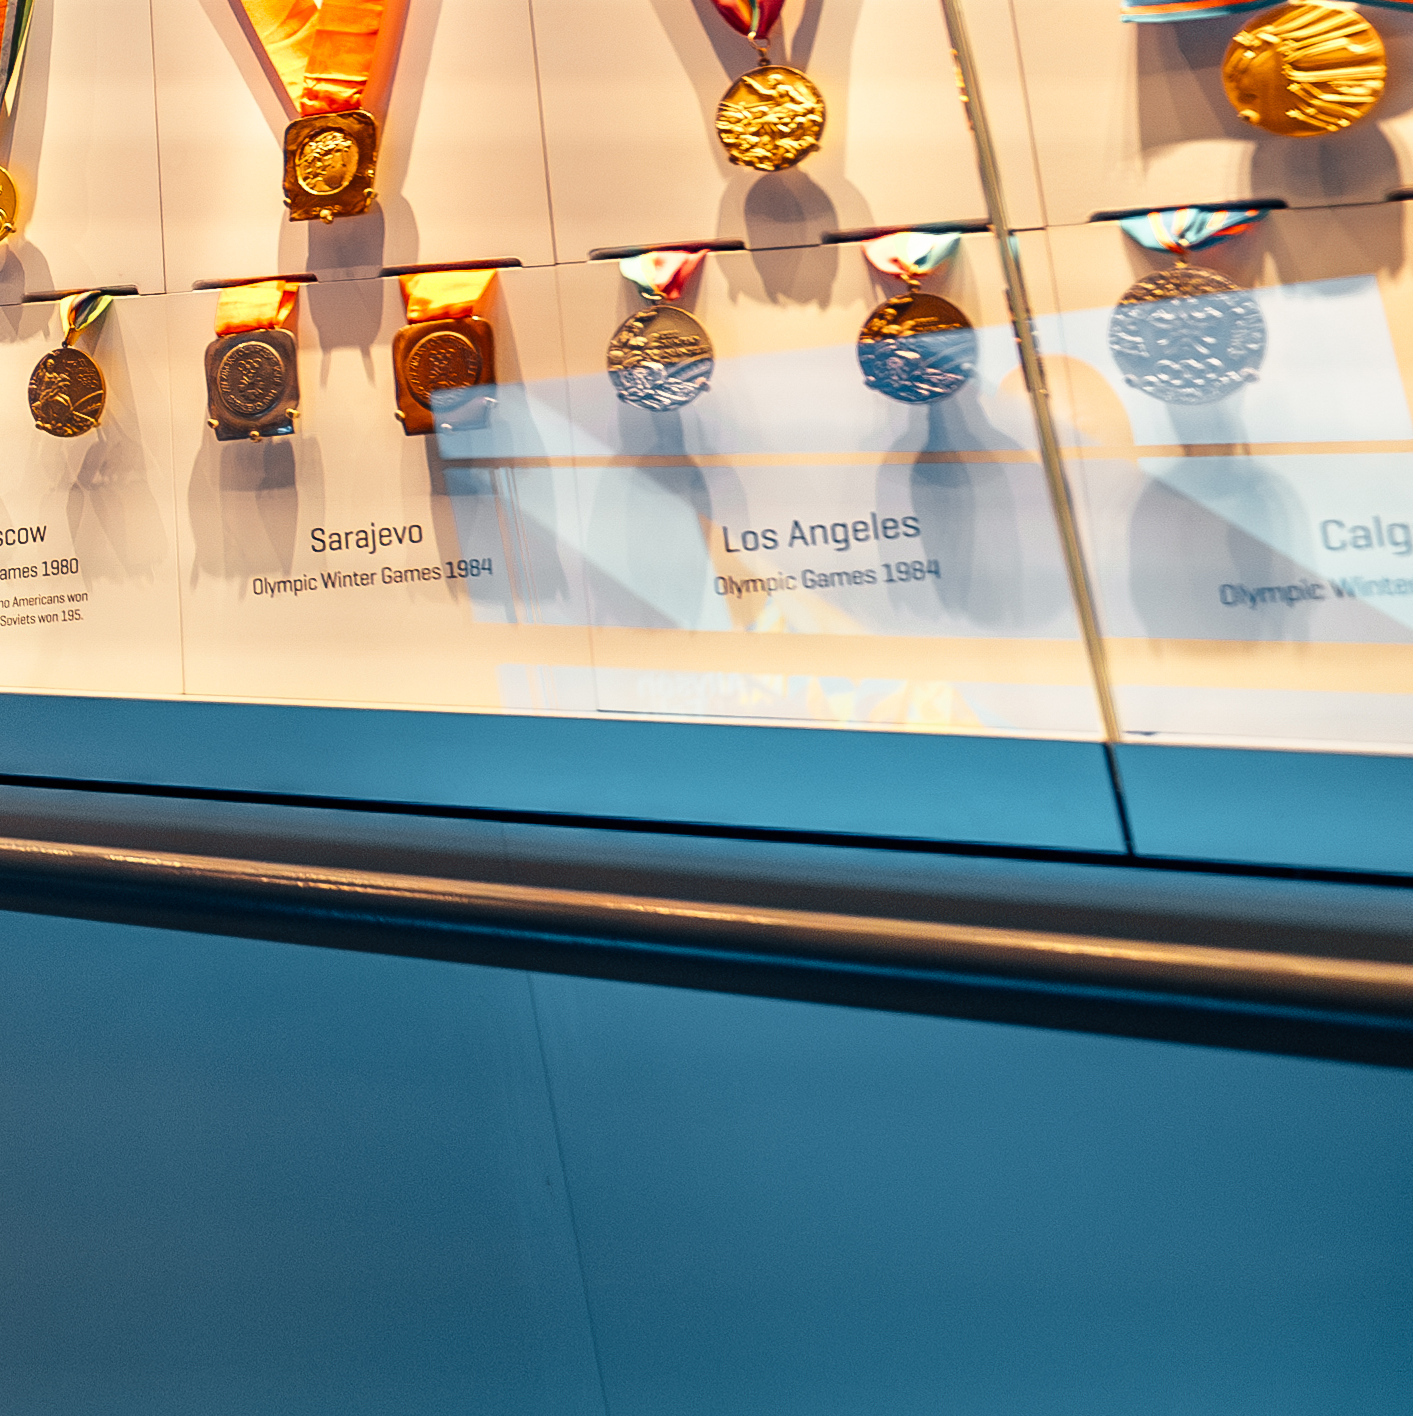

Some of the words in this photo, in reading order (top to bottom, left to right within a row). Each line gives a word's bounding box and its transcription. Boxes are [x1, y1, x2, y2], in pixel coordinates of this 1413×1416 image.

[310, 522, 423, 555] Sarajevo
[722, 525, 779, 553] Los
[787, 511, 921, 552] Angeles
[41, 557, 79, 577] 1980
[253, 574, 318, 598] Olympic
[320, 569, 378, 590] Winter
[381, 564, 442, 585] Games
[444, 557, 493, 579] 1984
[714, 571, 798, 600] Olympic
[800, 568, 878, 590] Games
[880, 558, 942, 584] 1984
[12, 593, 65, 609] Americans
[66, 592, 89, 603] won
[1219, 578, 1326, 610] Olympic
[0, 613, 36, 627] Soviets
[37, 612, 58, 624] won
